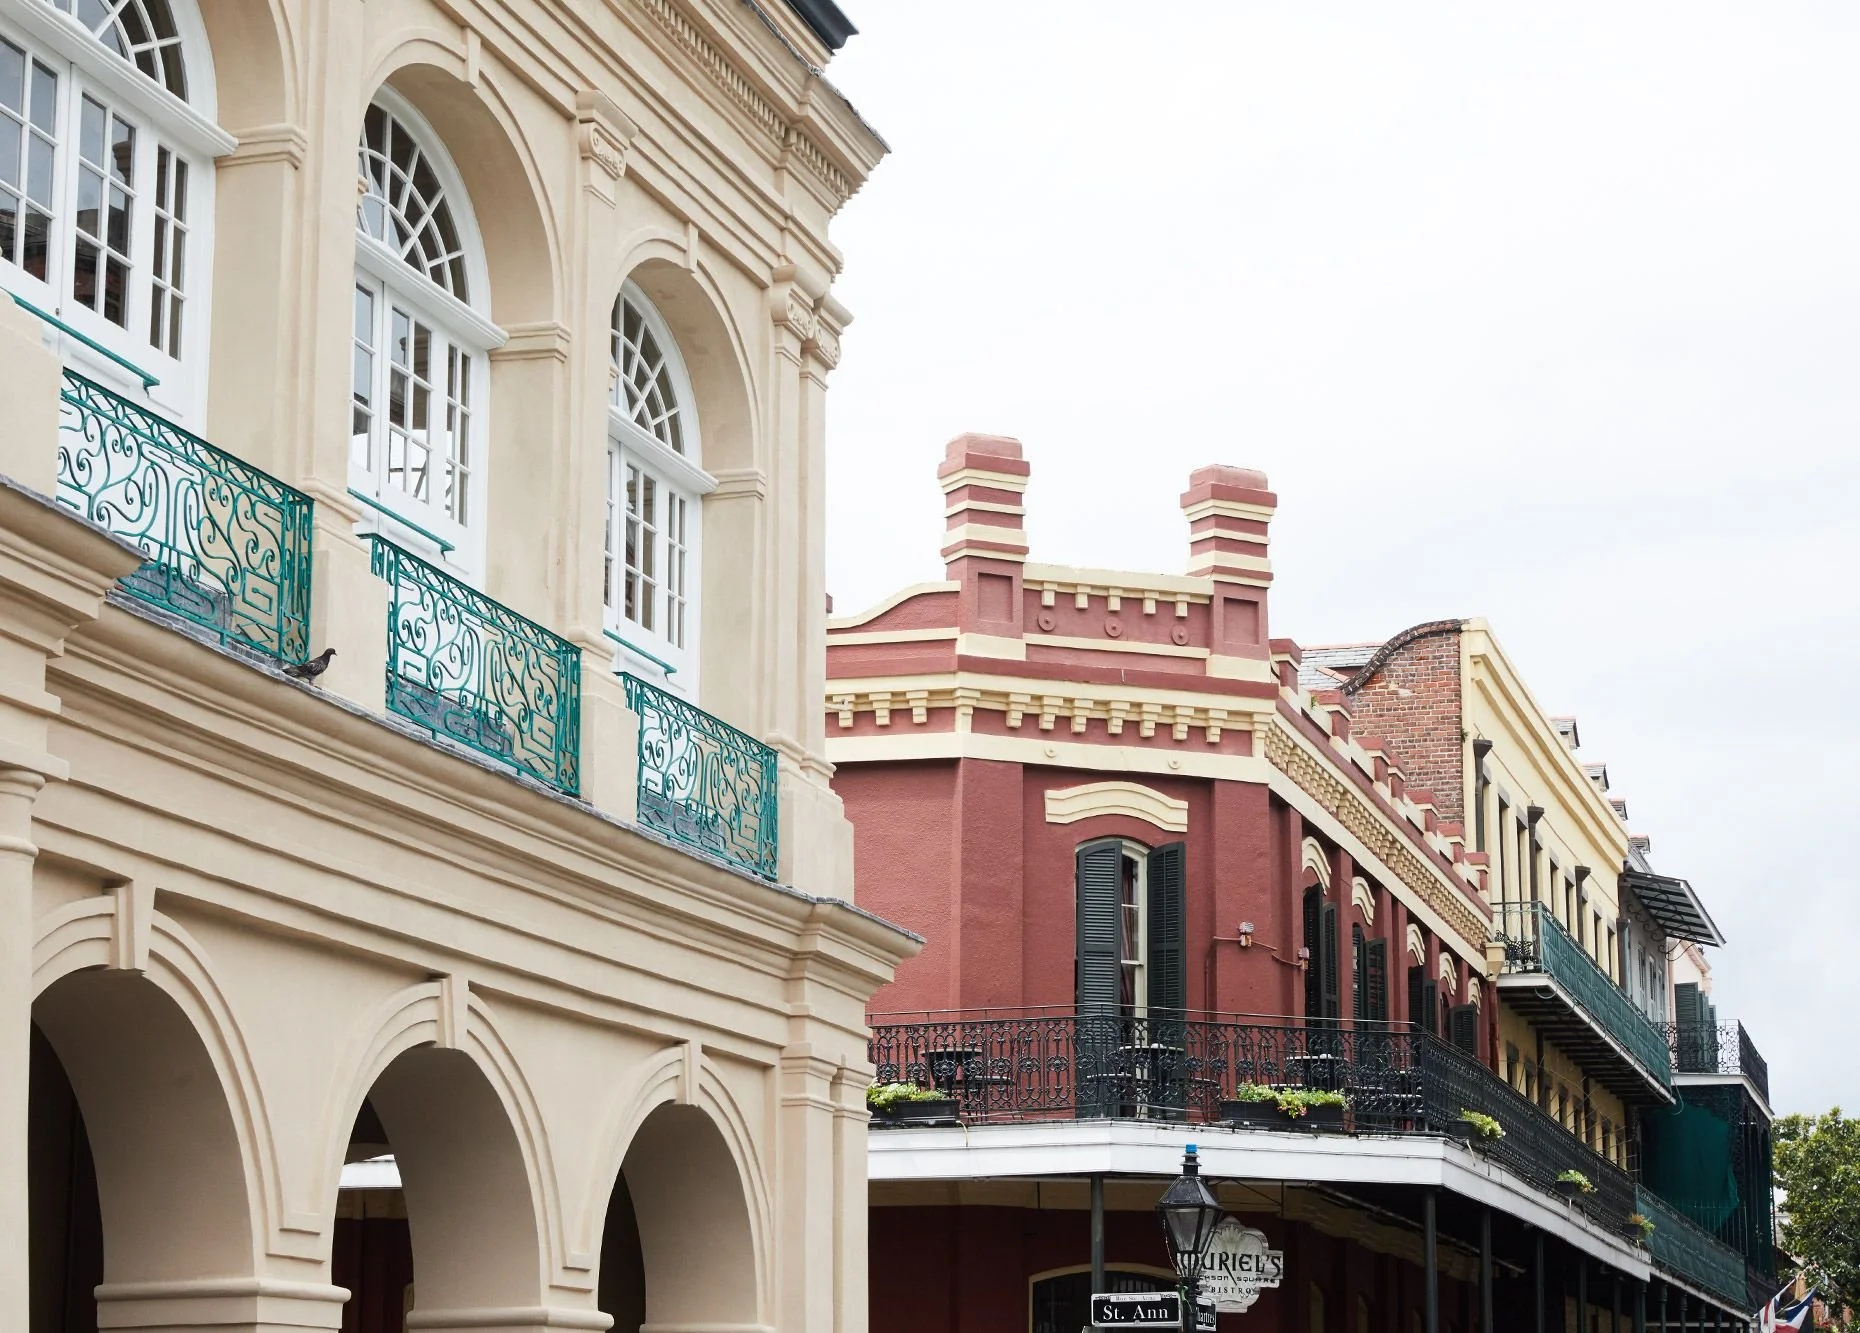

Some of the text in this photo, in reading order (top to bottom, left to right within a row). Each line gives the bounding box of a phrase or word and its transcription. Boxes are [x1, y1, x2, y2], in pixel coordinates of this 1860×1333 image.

[1236, 1276, 1276, 1284] SQUARE
[1211, 1286, 1252, 1294] BISTRO
[1103, 1304, 1169, 1321] St. Ann
